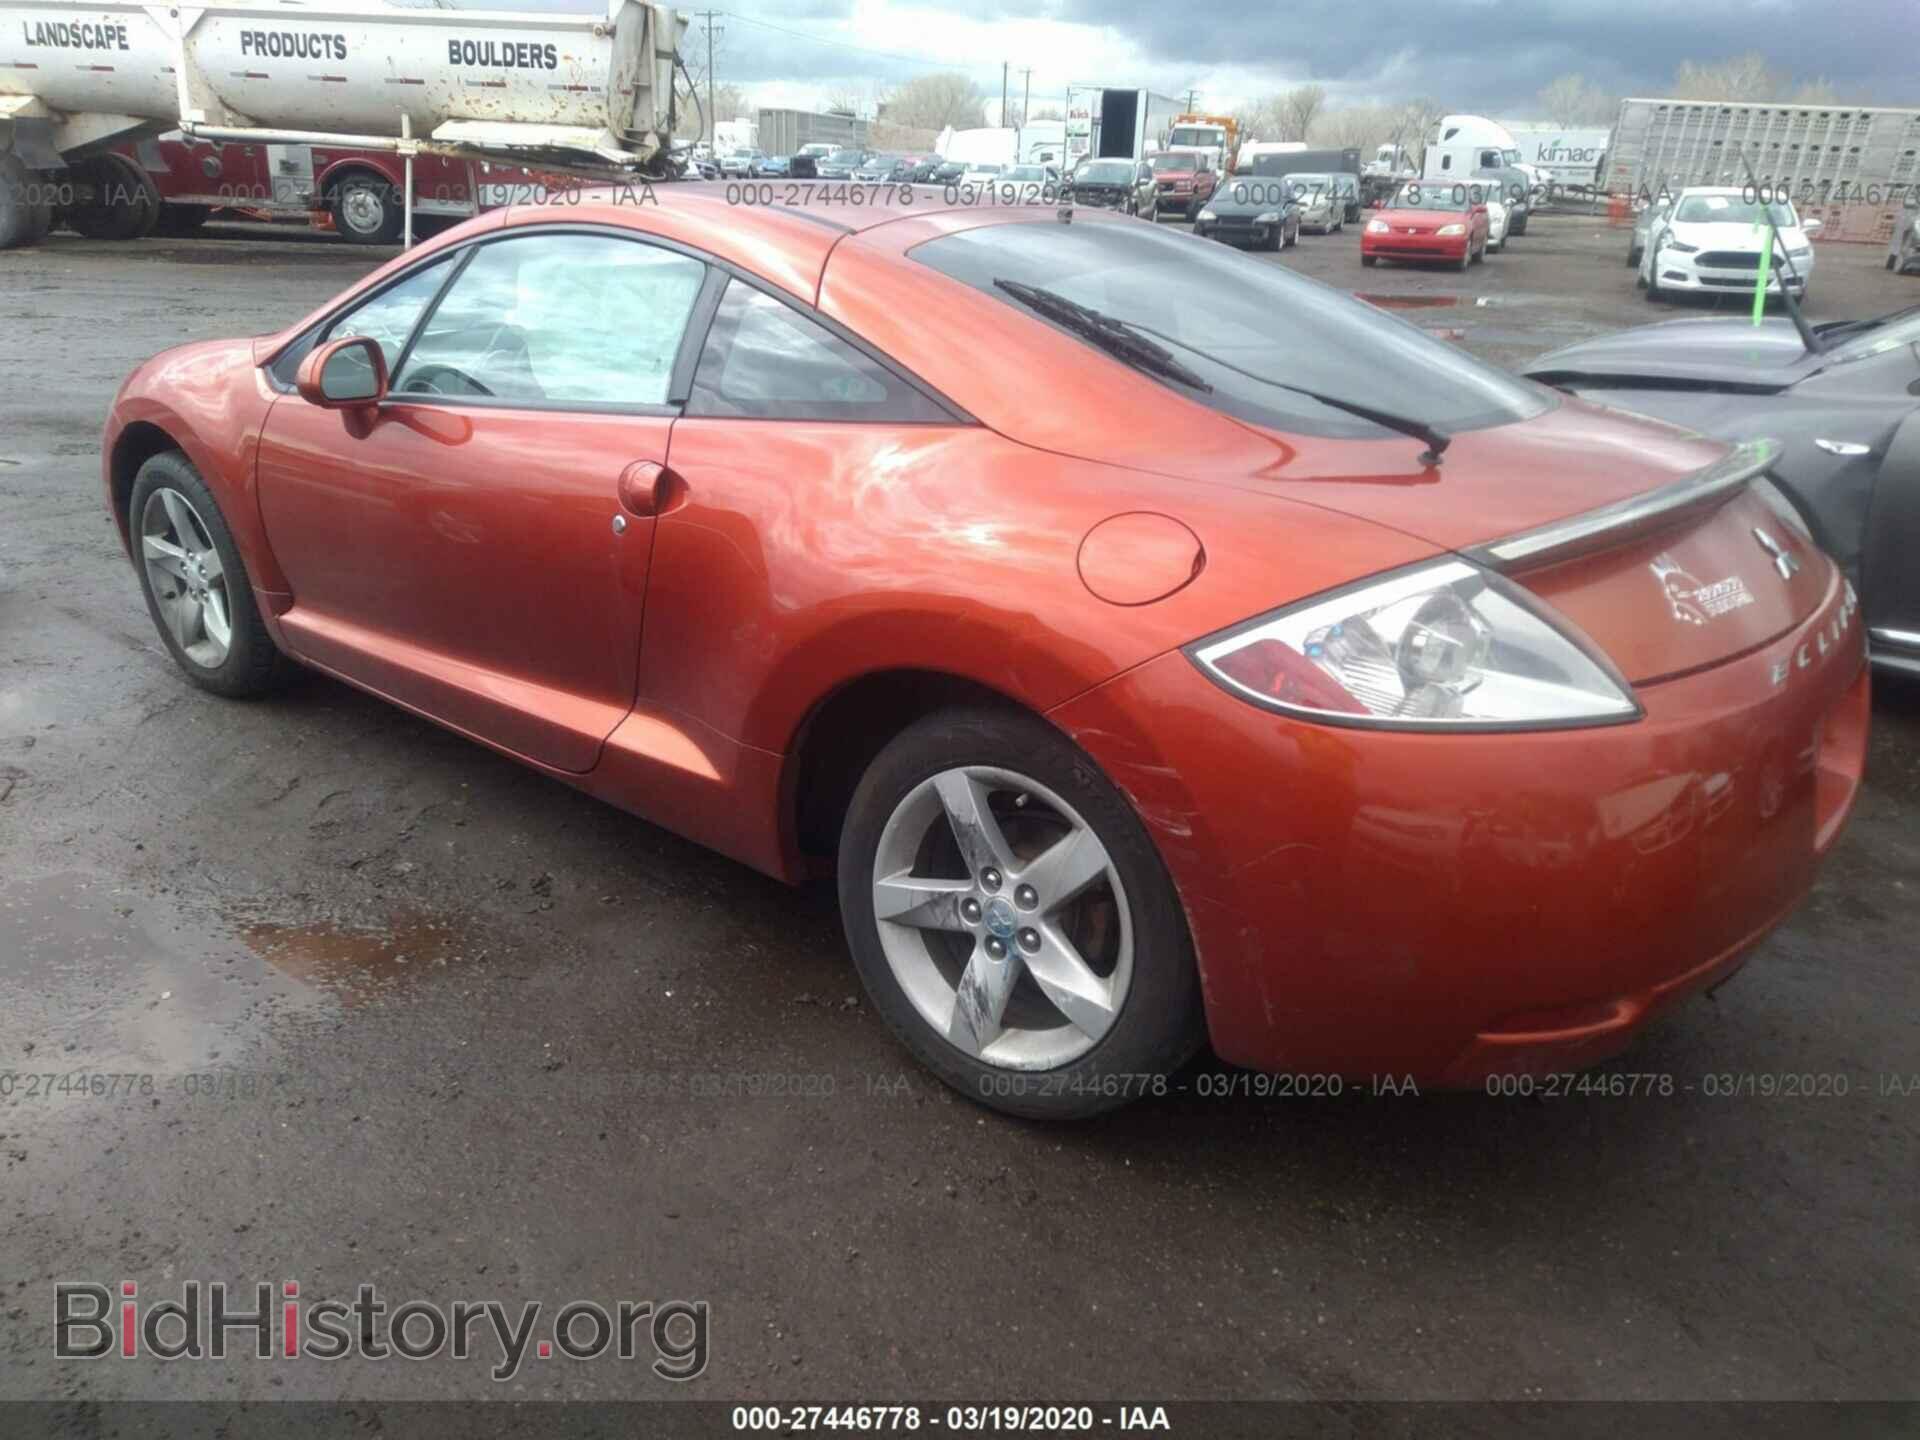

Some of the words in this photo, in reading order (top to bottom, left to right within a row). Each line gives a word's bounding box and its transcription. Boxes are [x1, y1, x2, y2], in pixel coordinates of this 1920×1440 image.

[23, 20, 130, 51] LANDSCAPE
[240, 29, 348, 60] PRODUCTS
[448, 39, 558, 69] BOULDERS
